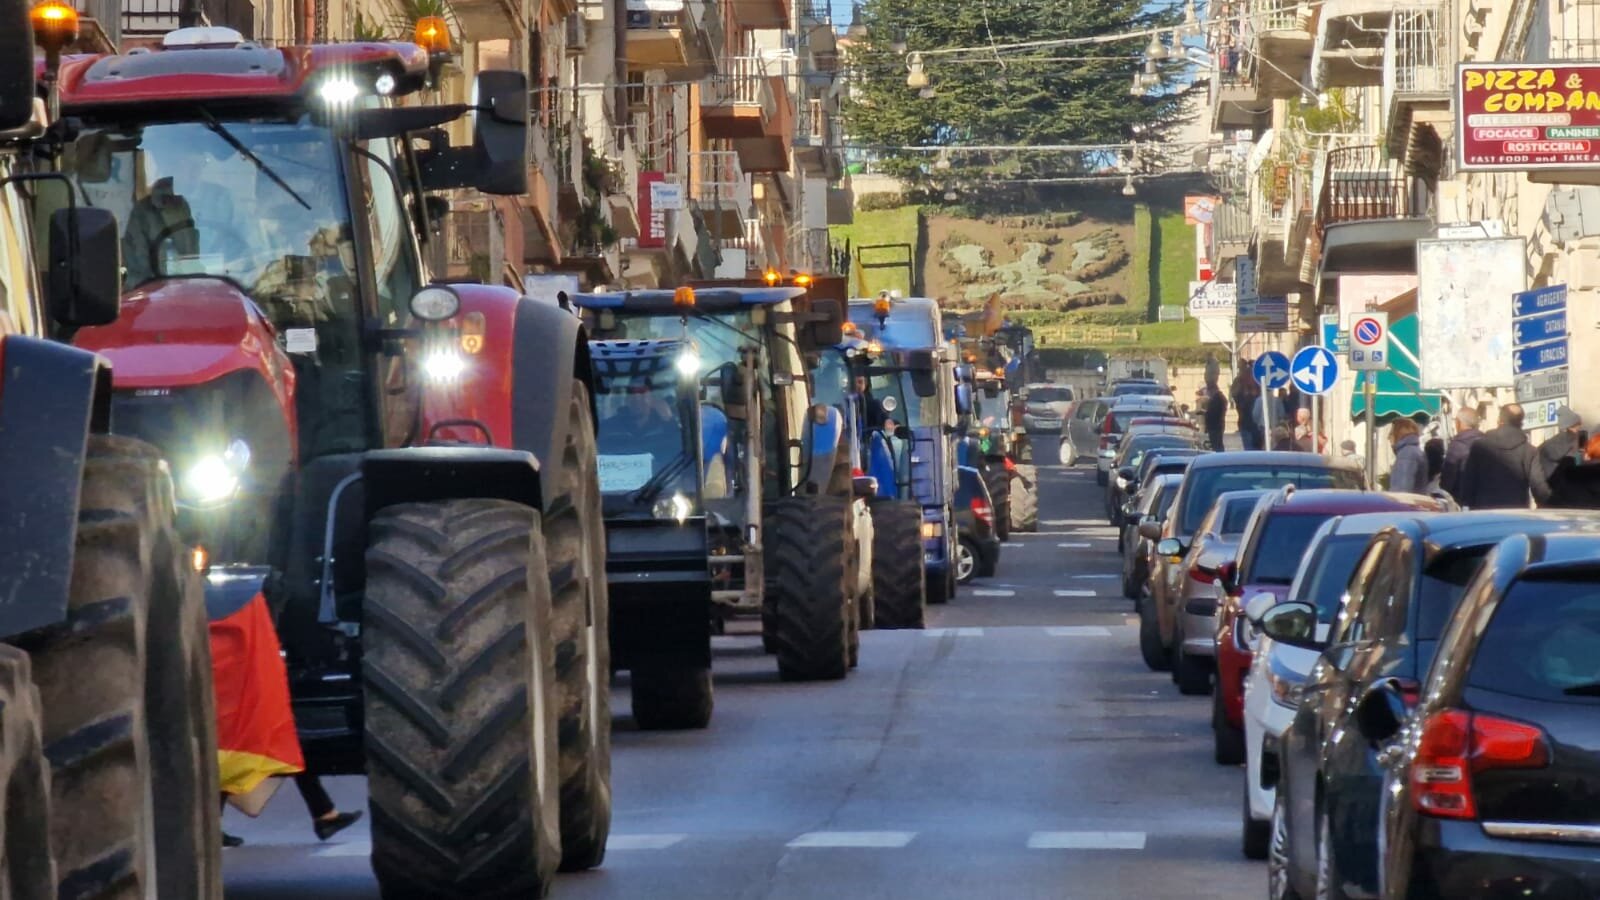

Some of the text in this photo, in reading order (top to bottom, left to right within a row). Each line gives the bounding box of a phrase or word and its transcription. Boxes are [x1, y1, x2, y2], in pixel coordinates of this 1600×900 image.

[1465, 69, 1582, 91] PIZZA &
[1478, 129, 1534, 139] FOCACCE
[1507, 141, 1584, 152] ROSTICCERIA
[1537, 291, 1566, 307] AGRIGENTO
[1545, 320, 1566, 333] CATANIA
[1540, 347, 1566, 363] SIRACUSA
